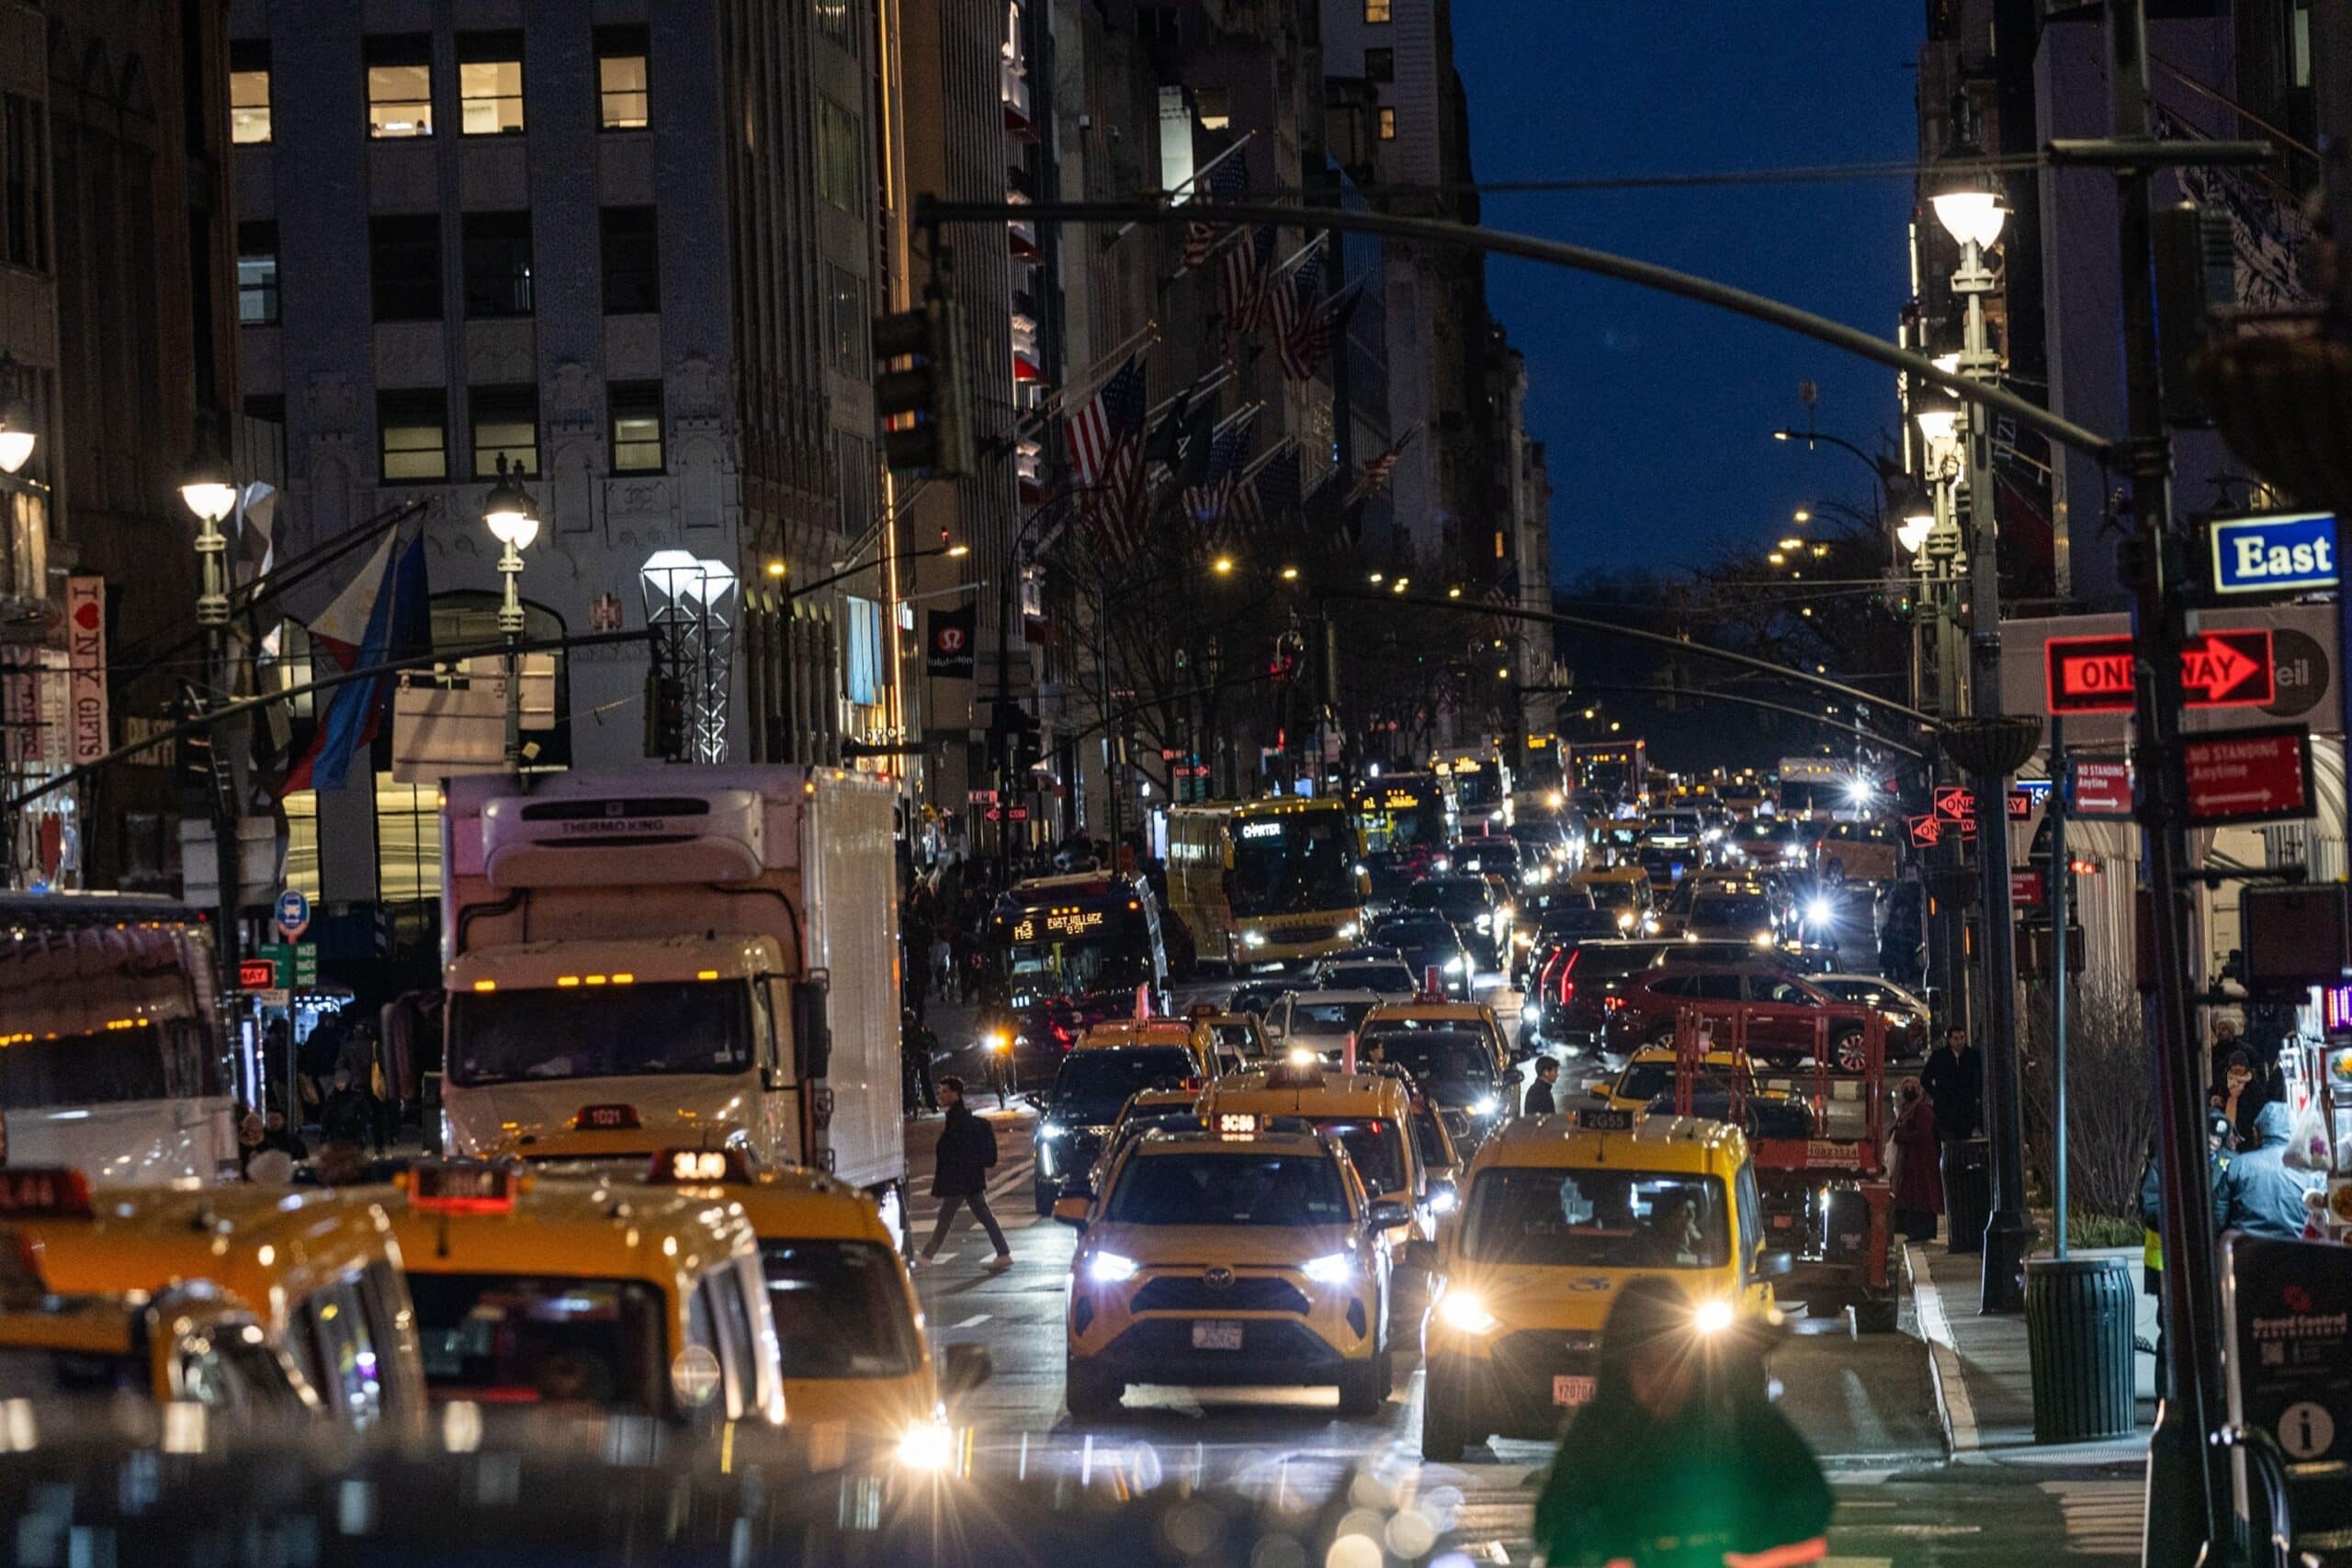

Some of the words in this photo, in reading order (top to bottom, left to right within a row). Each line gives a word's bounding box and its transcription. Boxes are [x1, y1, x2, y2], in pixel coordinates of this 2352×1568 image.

[2233, 536, 2333, 578] East
[2275, 659, 2309, 686] eil
[78, 697, 103, 756] GIFTS
[2077, 764, 2089, 776] NO
[2090, 764, 2125, 778] STANDING
[2078, 776, 2108, 790] Anytime
[2008, 798, 2024, 812] AY
[561, 820, 626, 834] THERMO
[628, 818, 663, 831] KING
[1921, 824, 1938, 836] ON
